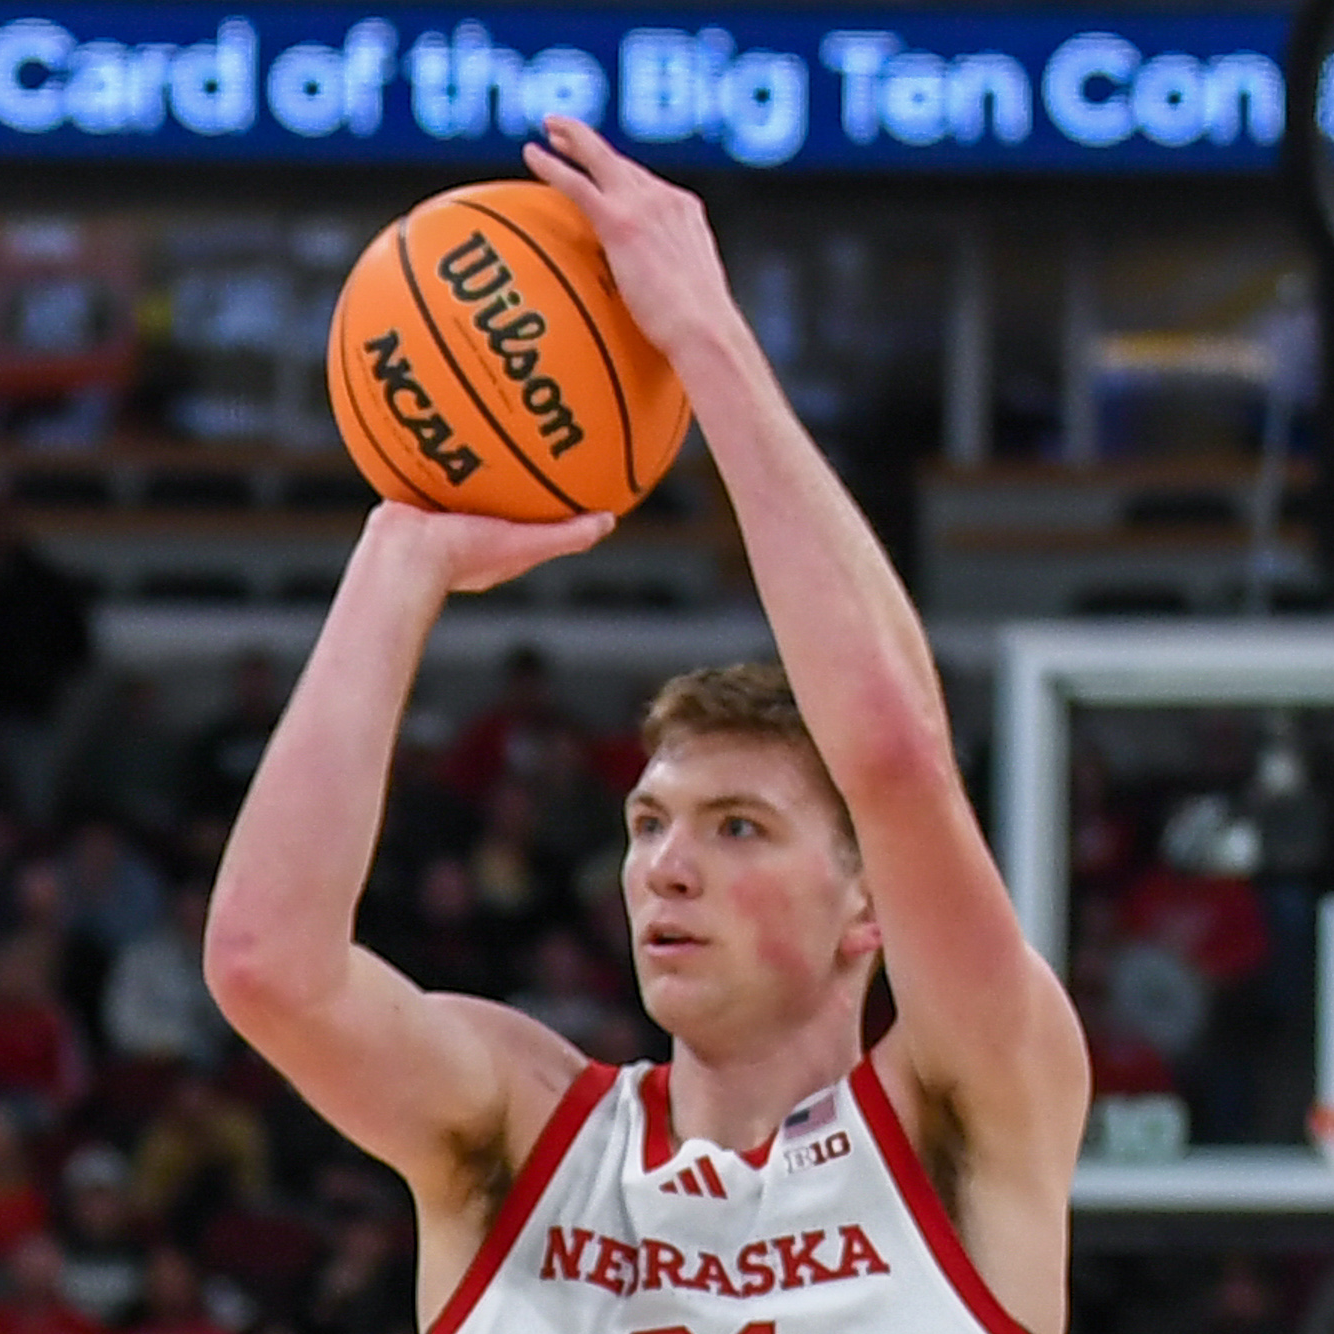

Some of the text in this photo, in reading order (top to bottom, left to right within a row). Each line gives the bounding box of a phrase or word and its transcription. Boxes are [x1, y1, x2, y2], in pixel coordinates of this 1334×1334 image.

[267, 16, 400, 138] of
[402, 18, 609, 140] the
[620, 26, 810, 168] Big
[819, 29, 1033, 146] Ten
[363, 328, 484, 487] NCAA
[436, 229, 586, 461] Wilson
